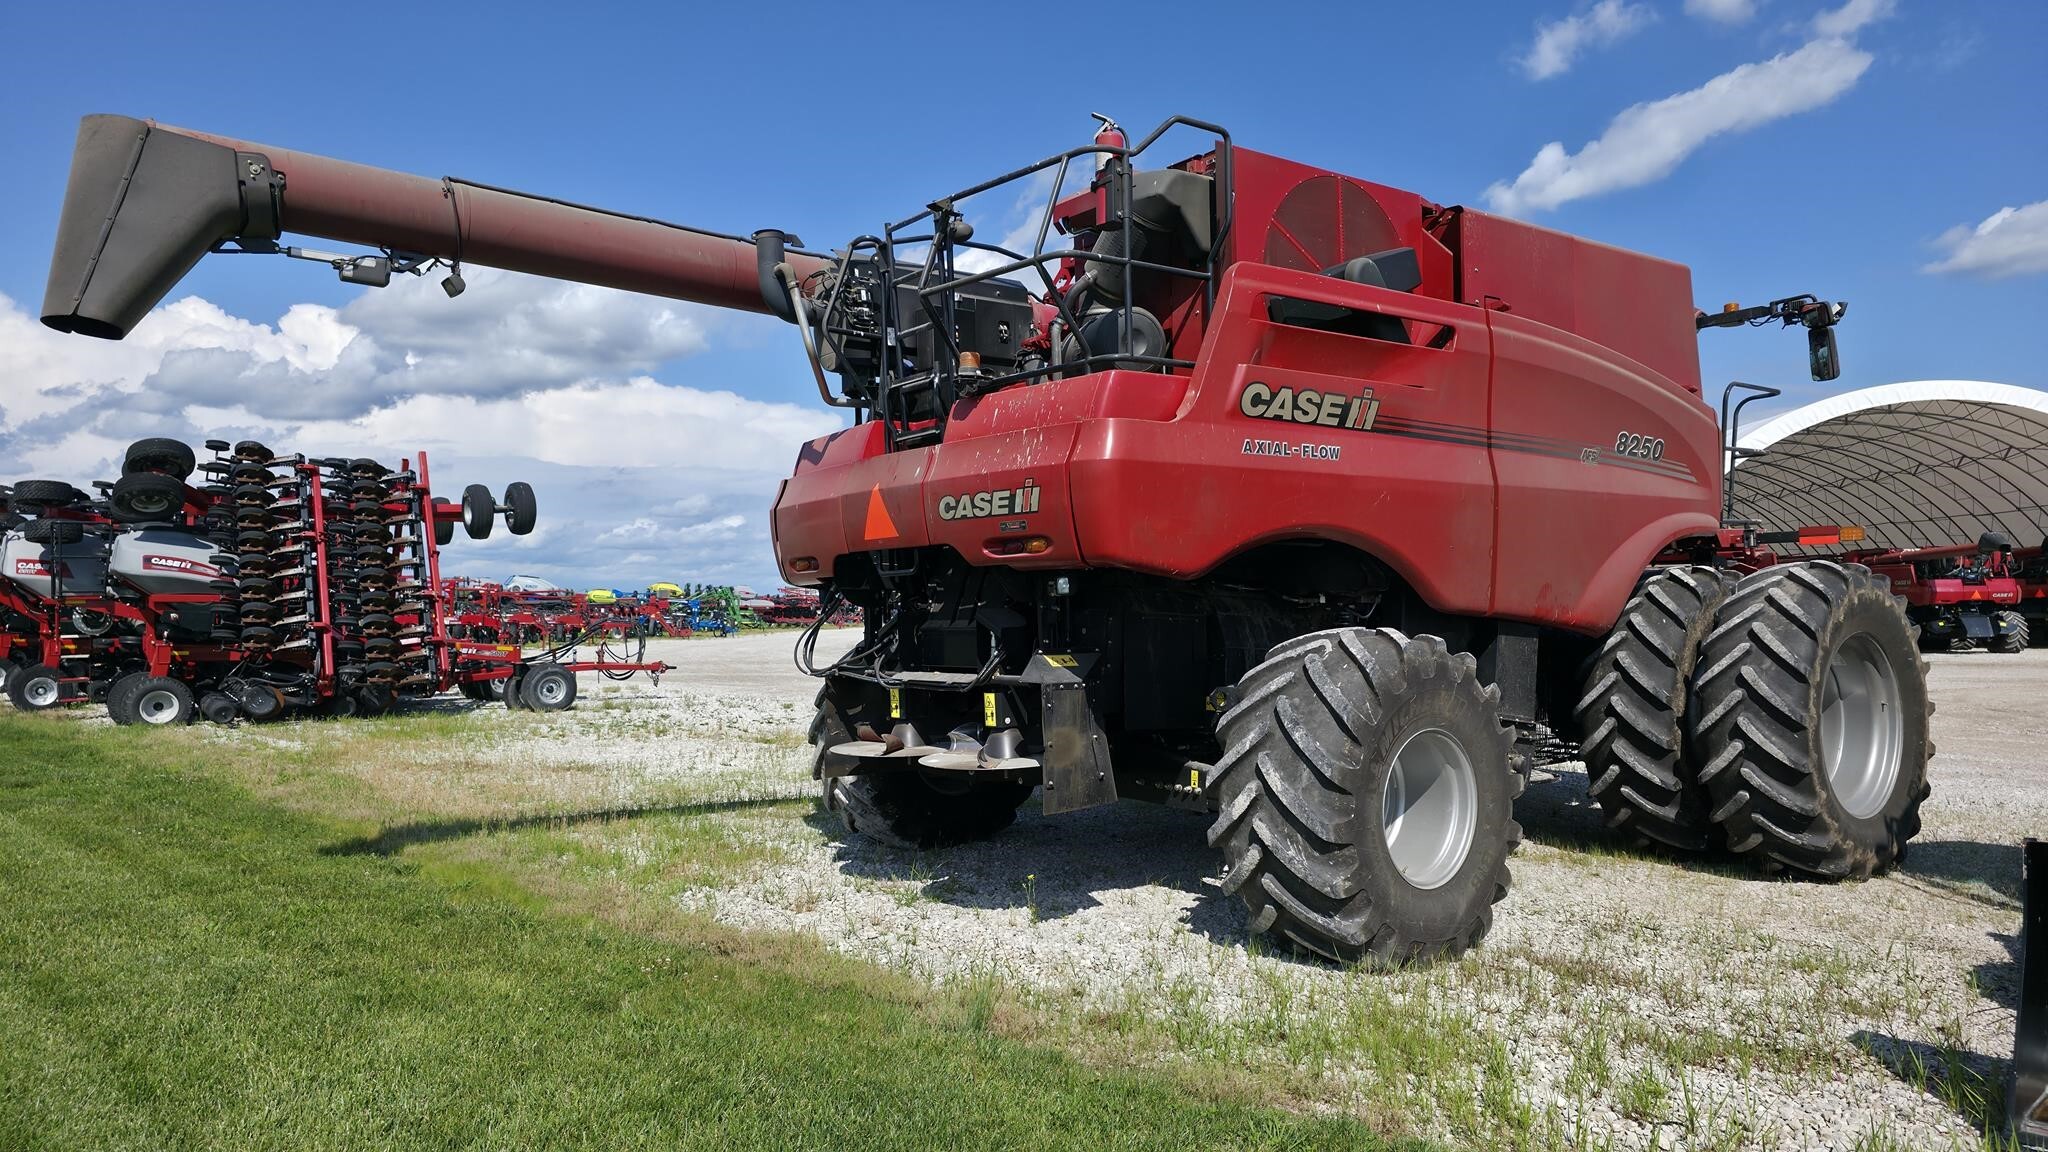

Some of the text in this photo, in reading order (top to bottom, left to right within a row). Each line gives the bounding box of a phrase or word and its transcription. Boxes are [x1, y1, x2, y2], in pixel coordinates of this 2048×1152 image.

[1240, 381, 1346, 426] CASE
[1241, 438, 1341, 460] AXIAL-FLOW
[1615, 431, 1664, 462] 8250
[938, 489, 1012, 520] CASE
[151, 557, 181, 568] CASE
